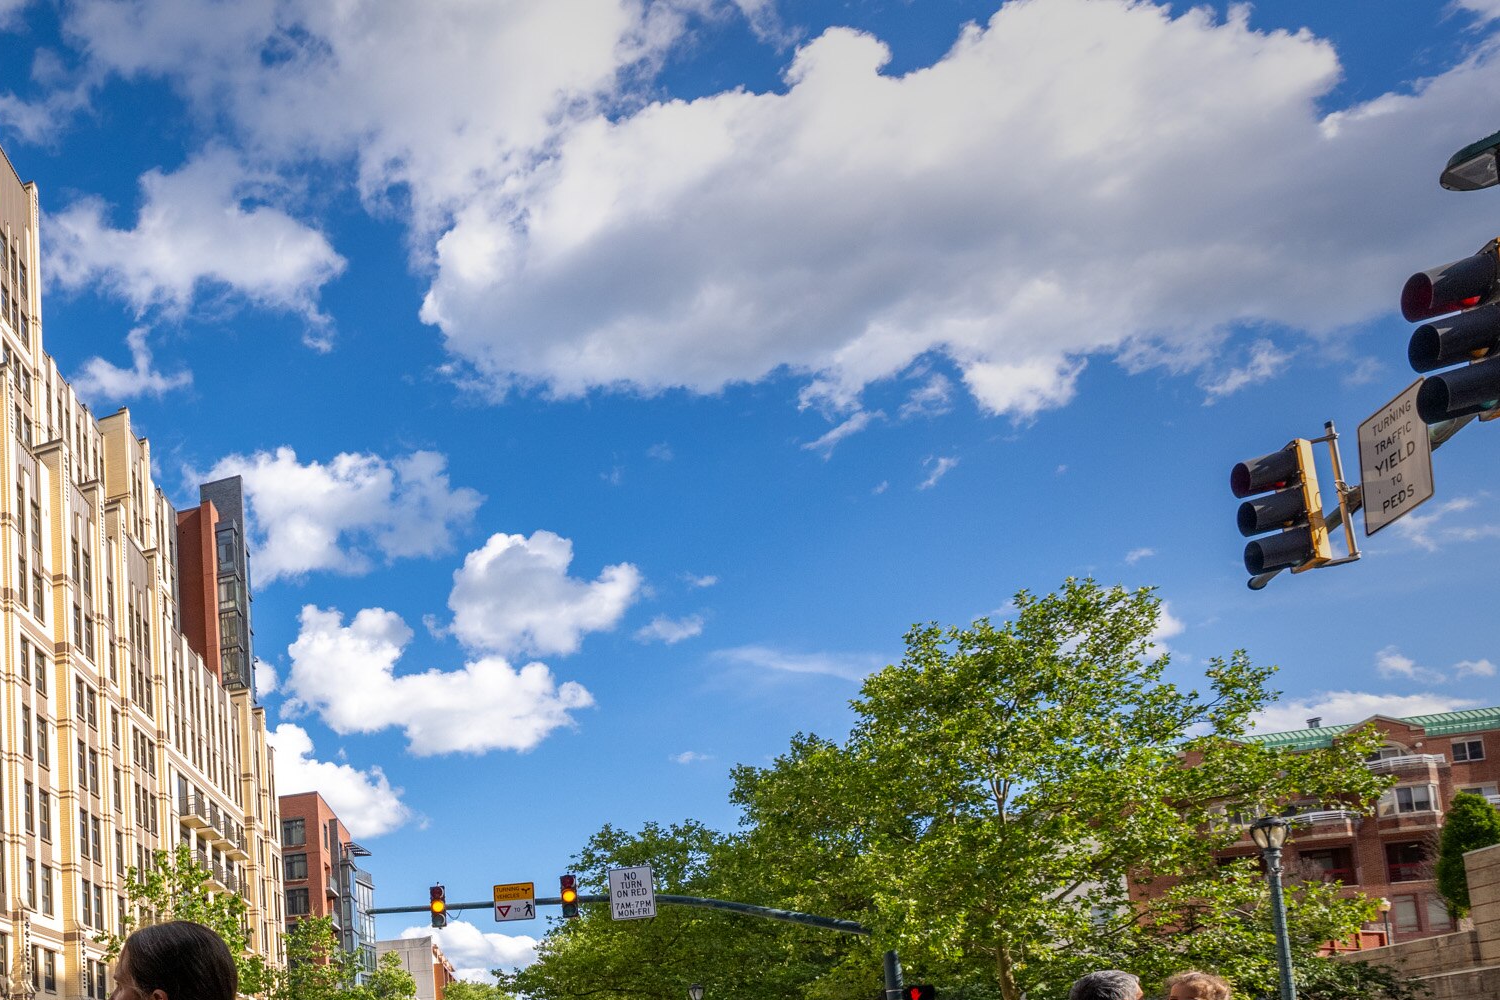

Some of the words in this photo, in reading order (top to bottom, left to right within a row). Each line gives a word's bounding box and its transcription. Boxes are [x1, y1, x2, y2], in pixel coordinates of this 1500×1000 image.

[1372, 400, 1411, 437] TURNING
[1374, 421, 1412, 455] TRAFFIC
[1375, 440, 1415, 477] YIELD
[1391, 472, 1402, 486] TO
[1382, 484, 1415, 514] PEDS
[623, 872, 637, 881] NO
[620, 880, 642, 889] TURN
[616, 890, 629, 898] ON
[631, 888, 648, 897] RED
[615, 900, 652, 911] 7AM-7PM
[617, 908, 651, 918] MON-FRI
